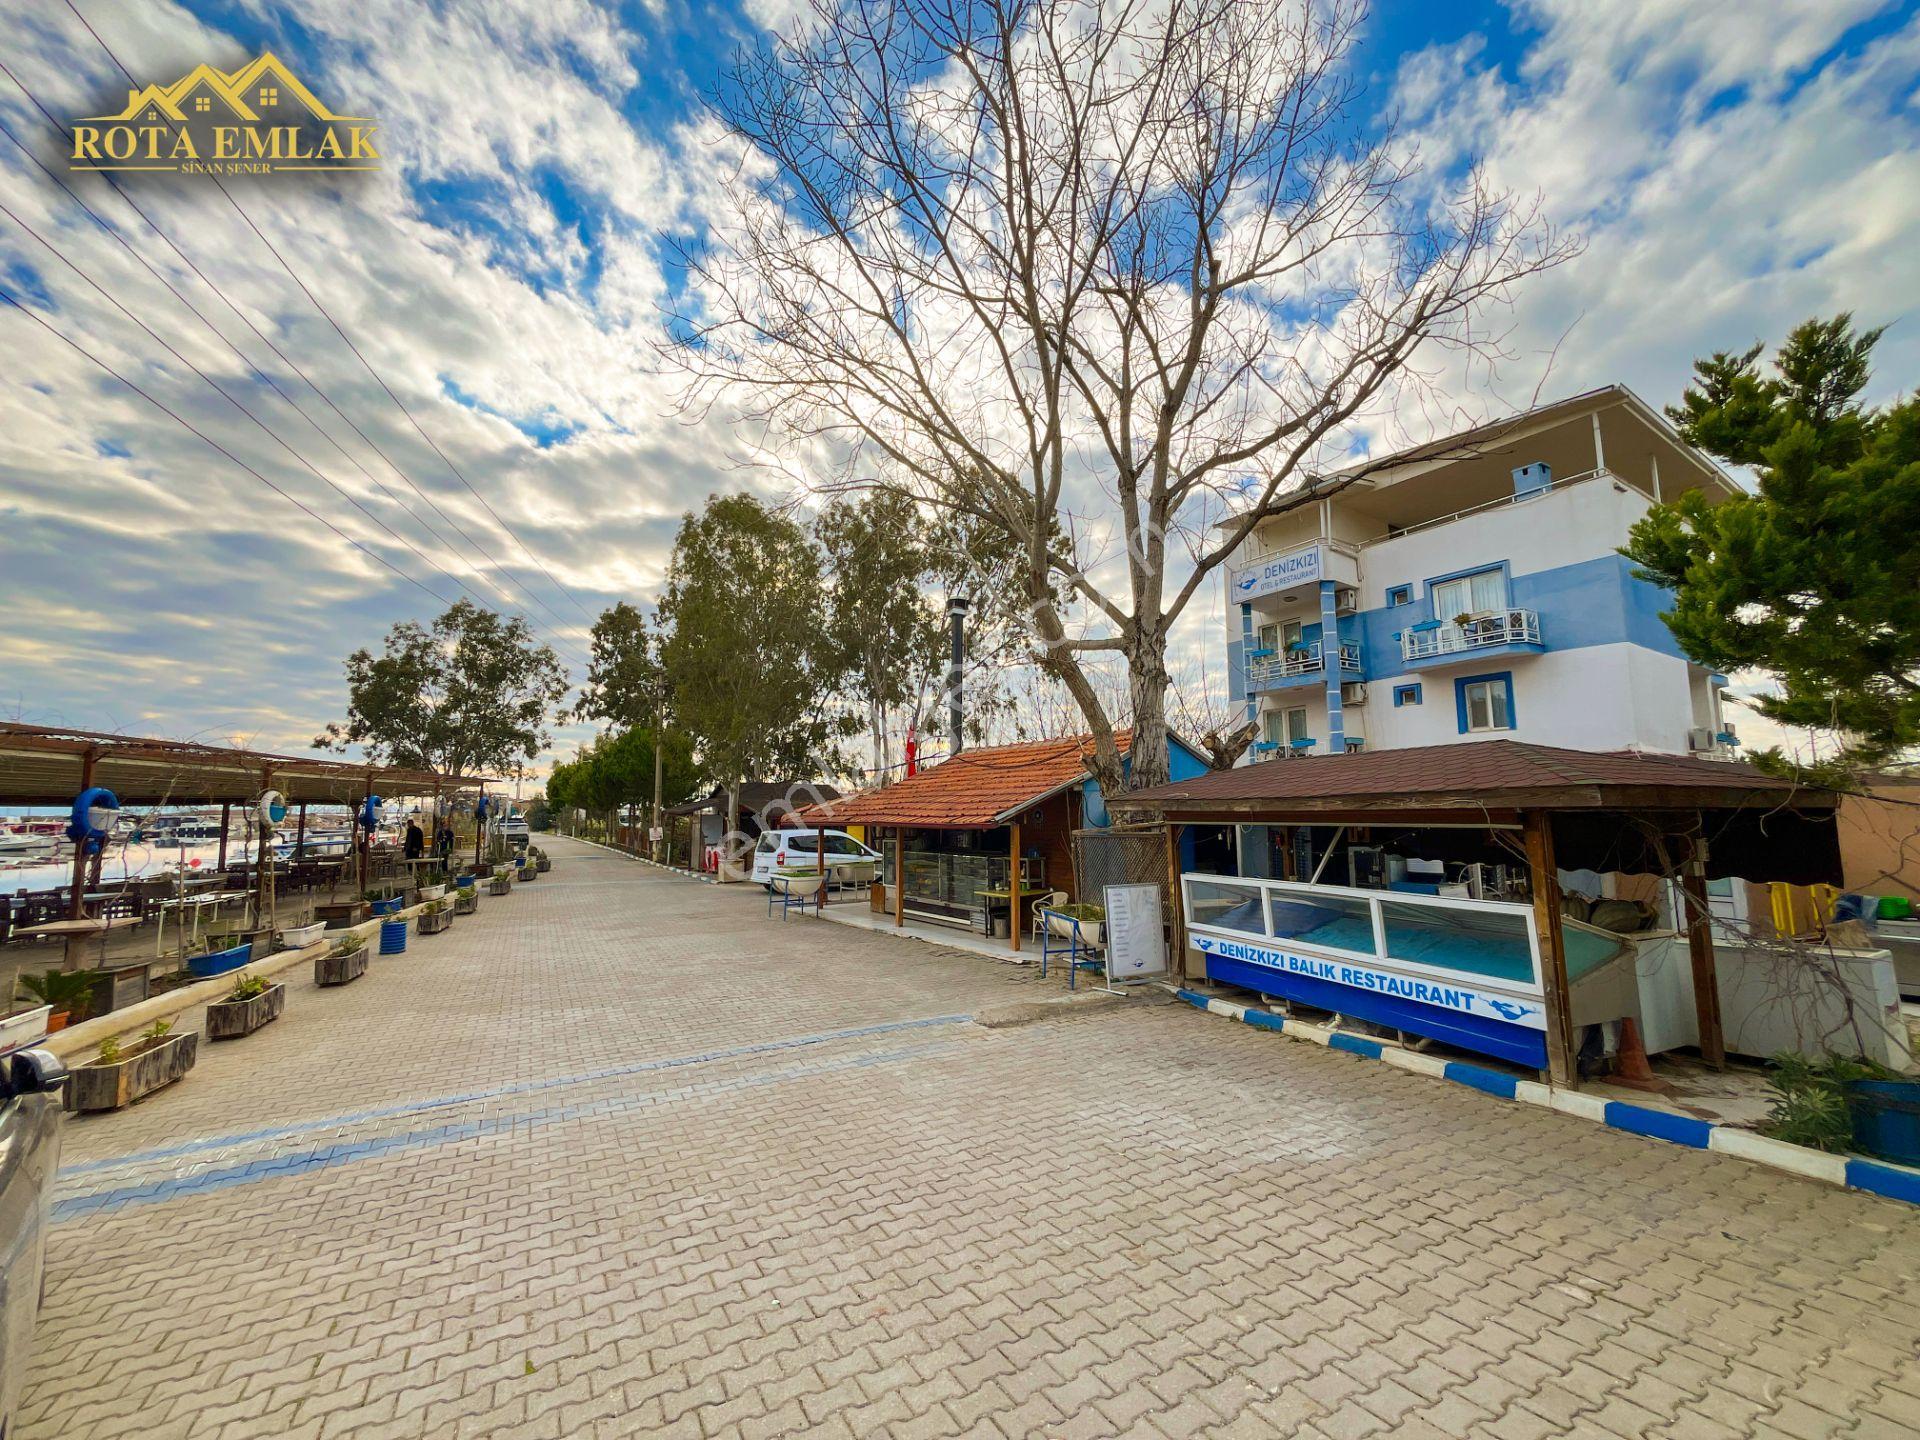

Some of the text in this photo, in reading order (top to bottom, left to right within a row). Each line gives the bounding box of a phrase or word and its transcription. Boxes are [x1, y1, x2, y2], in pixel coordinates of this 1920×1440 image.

[1279, 568, 1317, 585] RESTAURANT
[1219, 942, 1475, 1011] DENİZKIZI BALIK RESTAURANT
